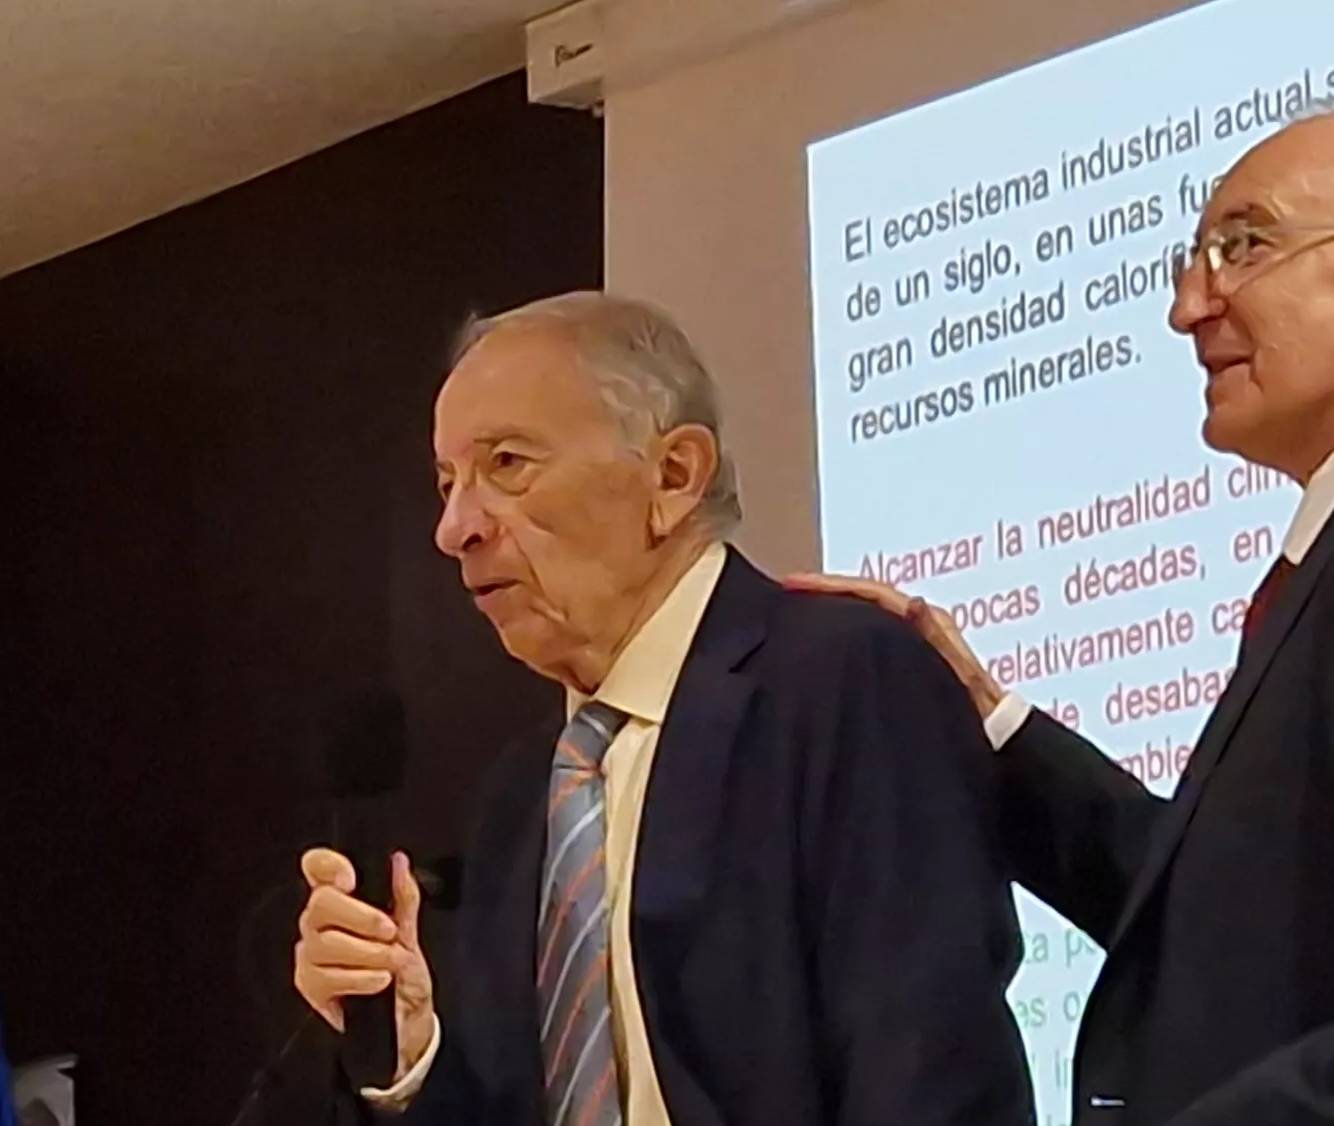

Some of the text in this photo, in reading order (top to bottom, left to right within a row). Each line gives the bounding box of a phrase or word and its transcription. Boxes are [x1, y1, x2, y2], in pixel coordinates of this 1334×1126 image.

[845, 219, 872, 262] El
[883, 168, 1050, 249] ecosistema
[1062, 107, 1200, 191] industrial
[1214, 70, 1311, 140] actual
[847, 283, 881, 322] de
[895, 269, 930, 307] un
[944, 240, 1021, 294] siglo,
[1037, 224, 1073, 262] en
[1088, 194, 1164, 247] unas
[849, 336, 913, 393] gran
[931, 281, 1065, 358] densidad
[851, 333, 1142, 443] recursos minerales.
[860, 535, 983, 587] Alcanzar
[998, 520, 1022, 559] la
[1038, 465, 1210, 549] neutralidad
[1065, 542, 1206, 605] décadas,
[1233, 525, 1273, 564] en
[987, 608, 1194, 686] relativamente
